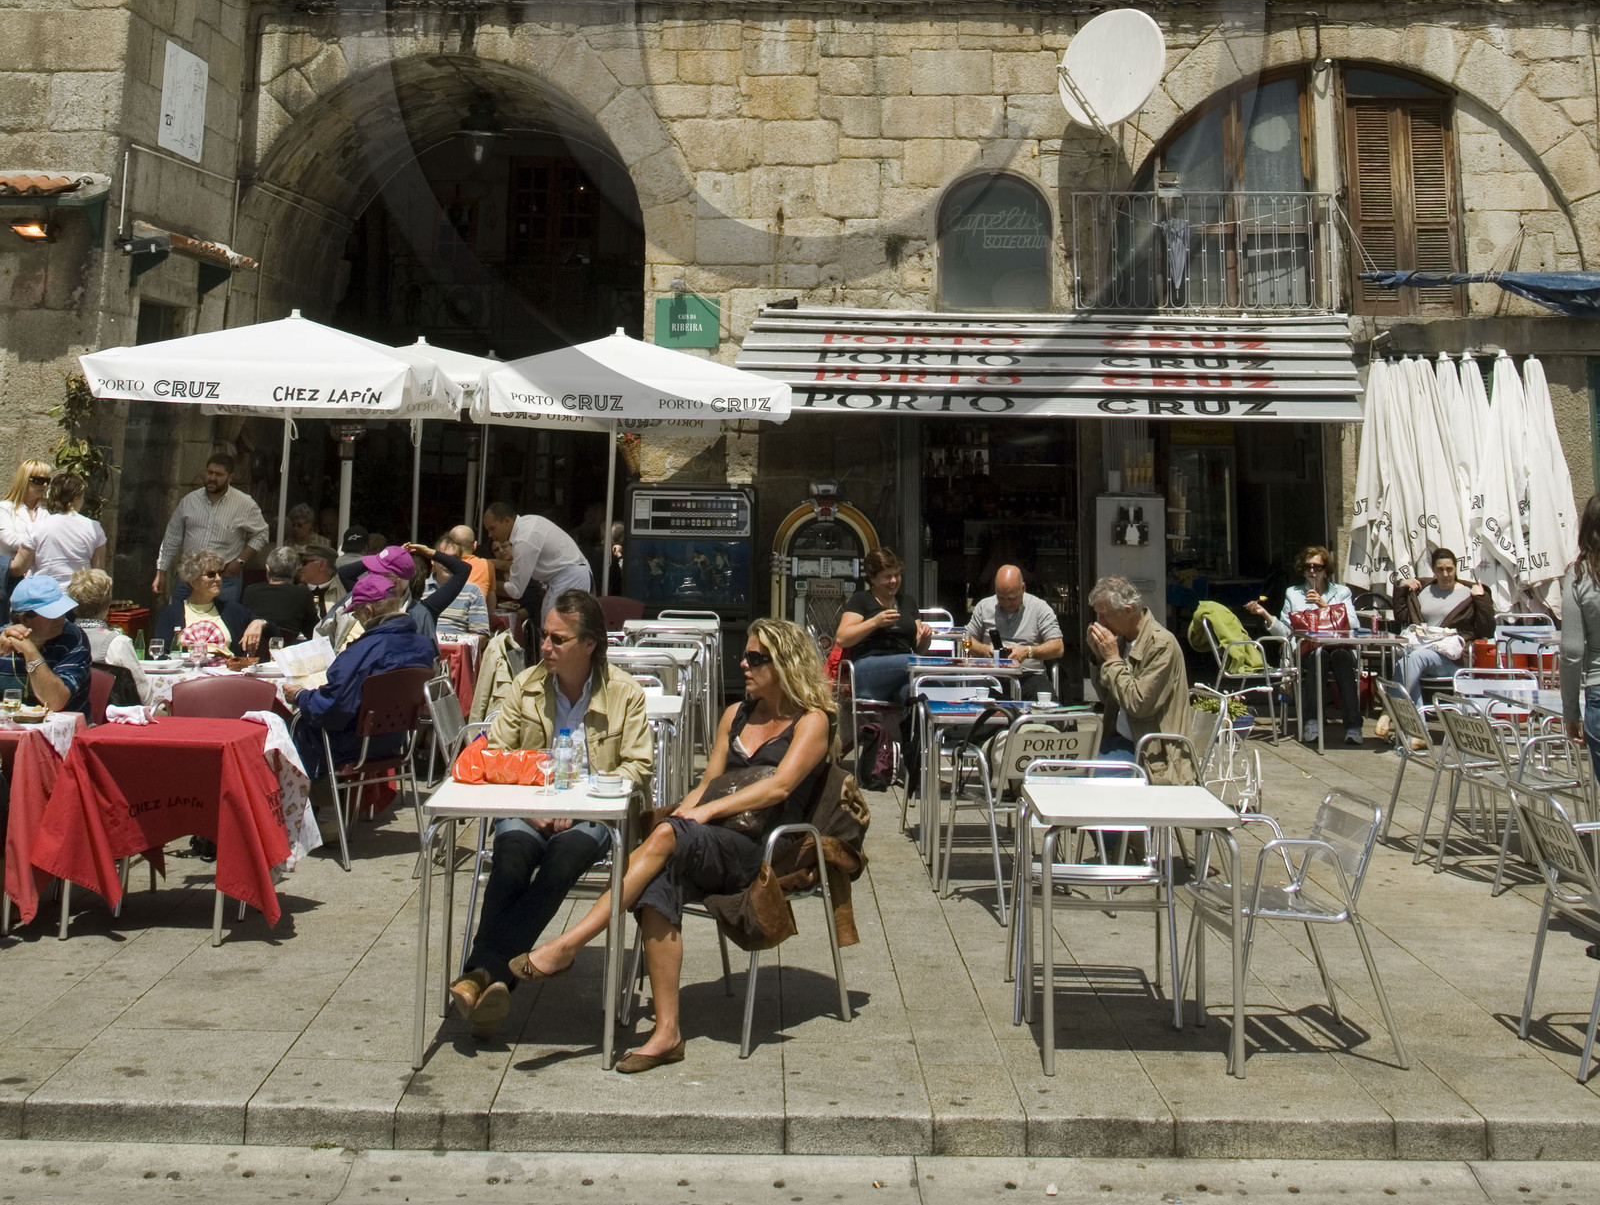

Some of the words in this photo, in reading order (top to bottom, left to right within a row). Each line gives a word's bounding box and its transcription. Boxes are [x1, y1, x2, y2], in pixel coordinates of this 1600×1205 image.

[671, 323, 703, 332] RIBEIRA
[821, 332, 1023, 346] PORTO
[1101, 336, 1271, 350] CRUZ
[815, 351, 1022, 366] PORTO
[1101, 356, 1274, 371] CRUZ
[814, 368, 1023, 386] PORTO
[1101, 374, 1279, 388] CRUZ
[98, 378, 145, 392] PORTO
[153, 379, 221, 399] CRUZ
[272, 386, 320, 403] CHEZ
[510, 392, 554, 407] PORTO
[561, 394, 624, 412] CRUZ
[659, 398, 703, 410] PORTO
[710, 397, 772, 413] CRUZ
[801, 392, 1015, 413] PORTO
[1097, 397, 1278, 416] CRUZ
[1452, 717, 1484, 734] PORTO
[1022, 738, 1079, 752] PORTO
[1457, 731, 1496, 755] CRUZ
[1015, 753, 1080, 773] CRUZ
[128, 799, 162, 818] CHEZ
[1541, 838, 1585, 874] CRUZ
